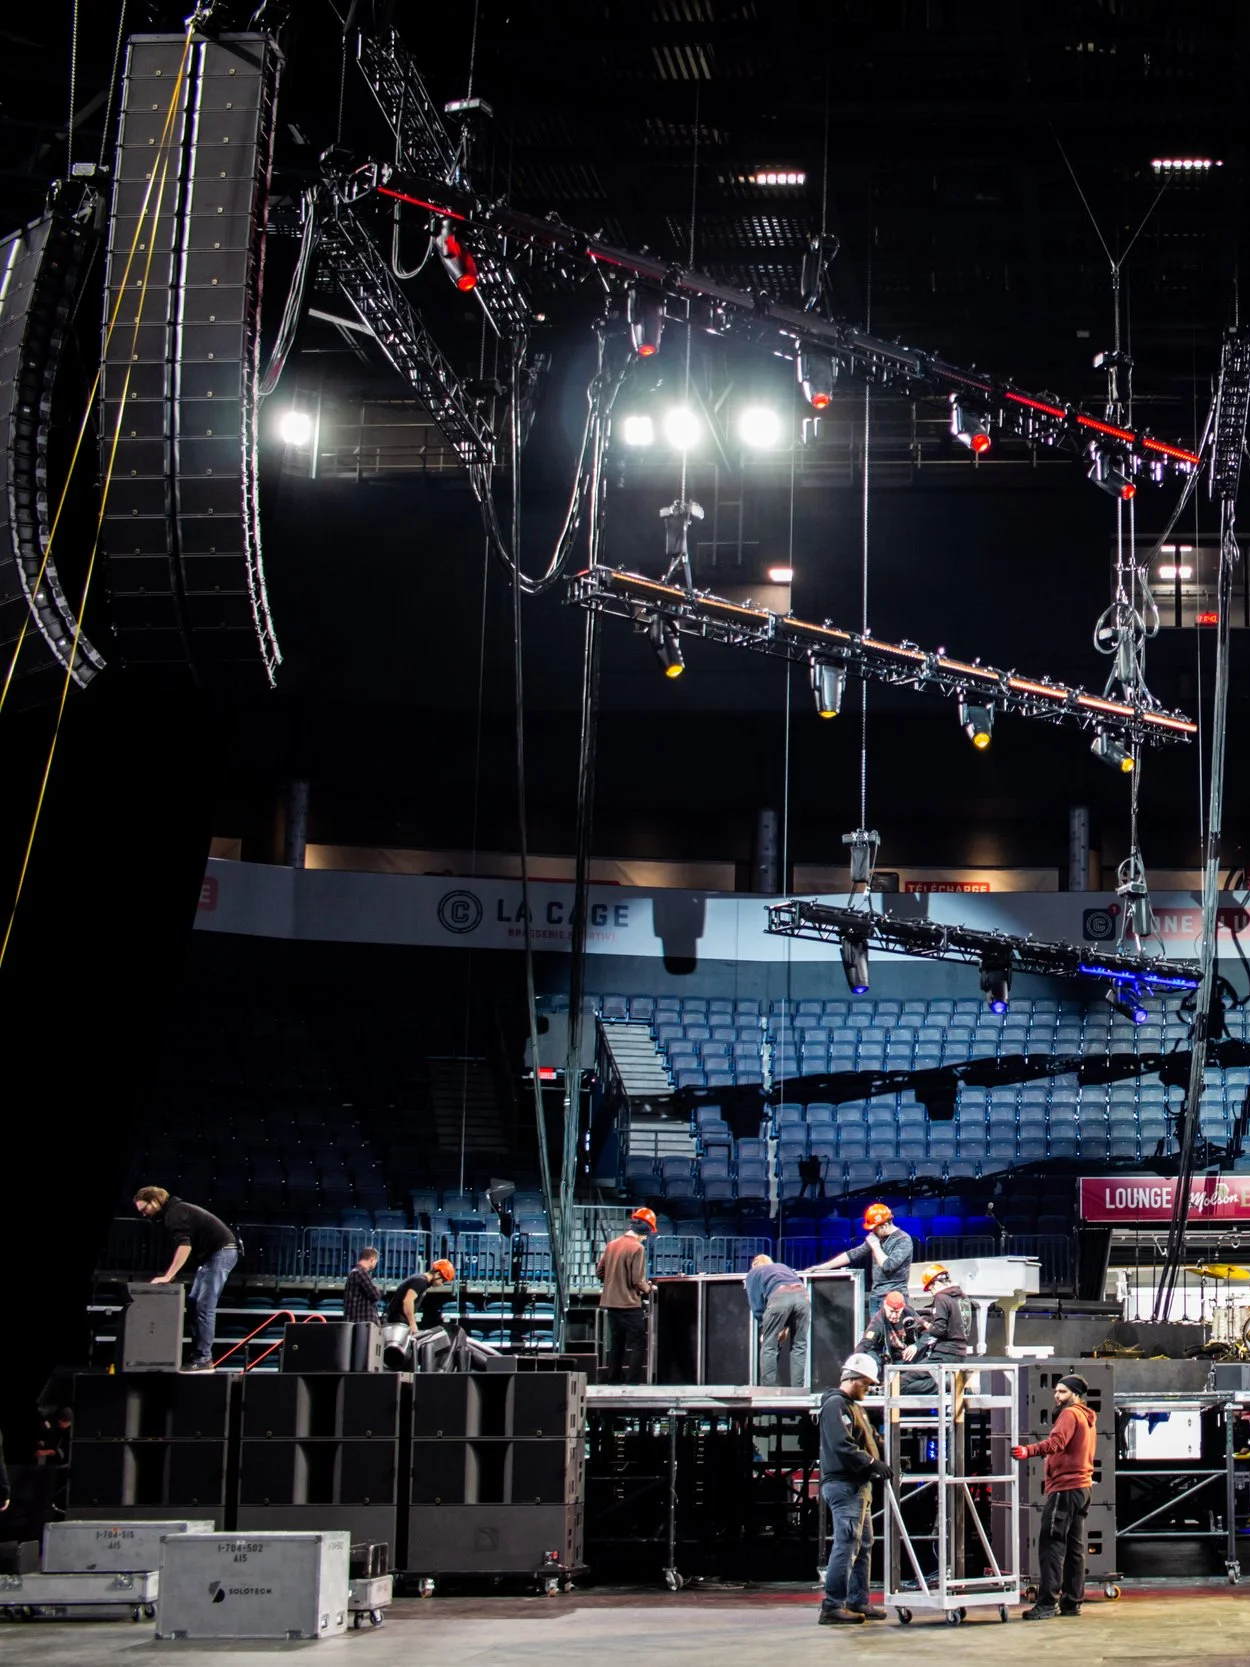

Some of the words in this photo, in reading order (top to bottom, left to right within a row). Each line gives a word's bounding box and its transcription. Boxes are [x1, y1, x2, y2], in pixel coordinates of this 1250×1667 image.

[497, 899, 532, 923] LA
[547, 901, 629, 927] CGE
[1151, 915, 1194, 933] ONE
[1105, 1187, 1172, 1209] LOUNGE
[1188, 1190, 1239, 1213] Molson
[229, 1588, 272, 1596] SOLOTECH
